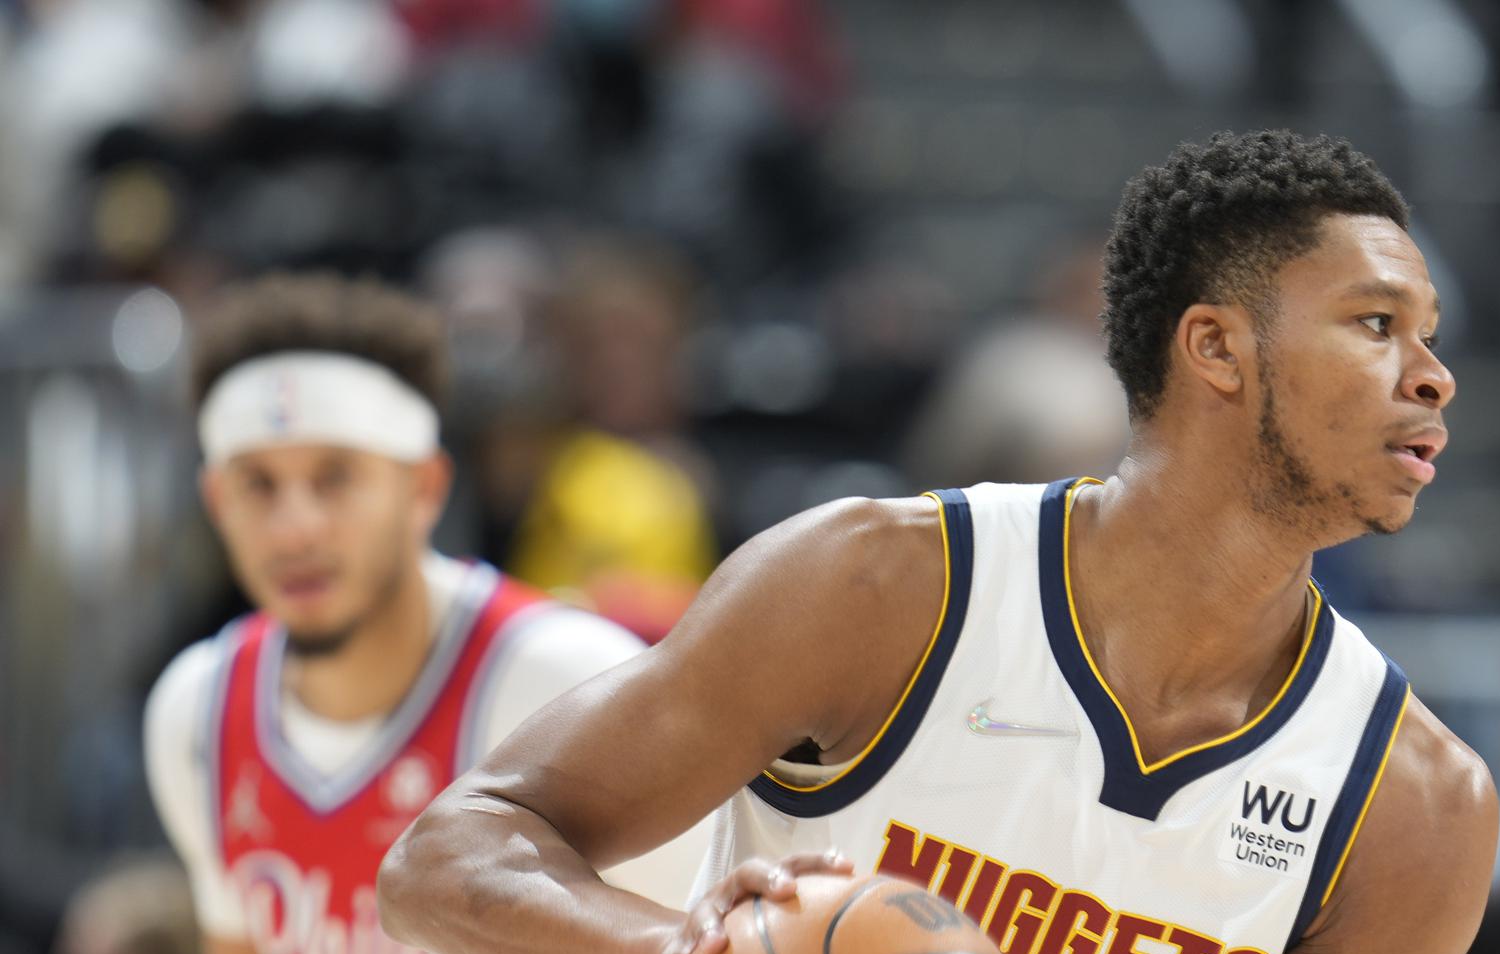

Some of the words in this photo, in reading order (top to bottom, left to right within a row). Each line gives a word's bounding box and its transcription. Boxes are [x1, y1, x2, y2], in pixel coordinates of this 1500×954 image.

[1241, 780, 1317, 834] WU
[1230, 821, 1306, 857] Western
[1235, 843, 1289, 872] Union
